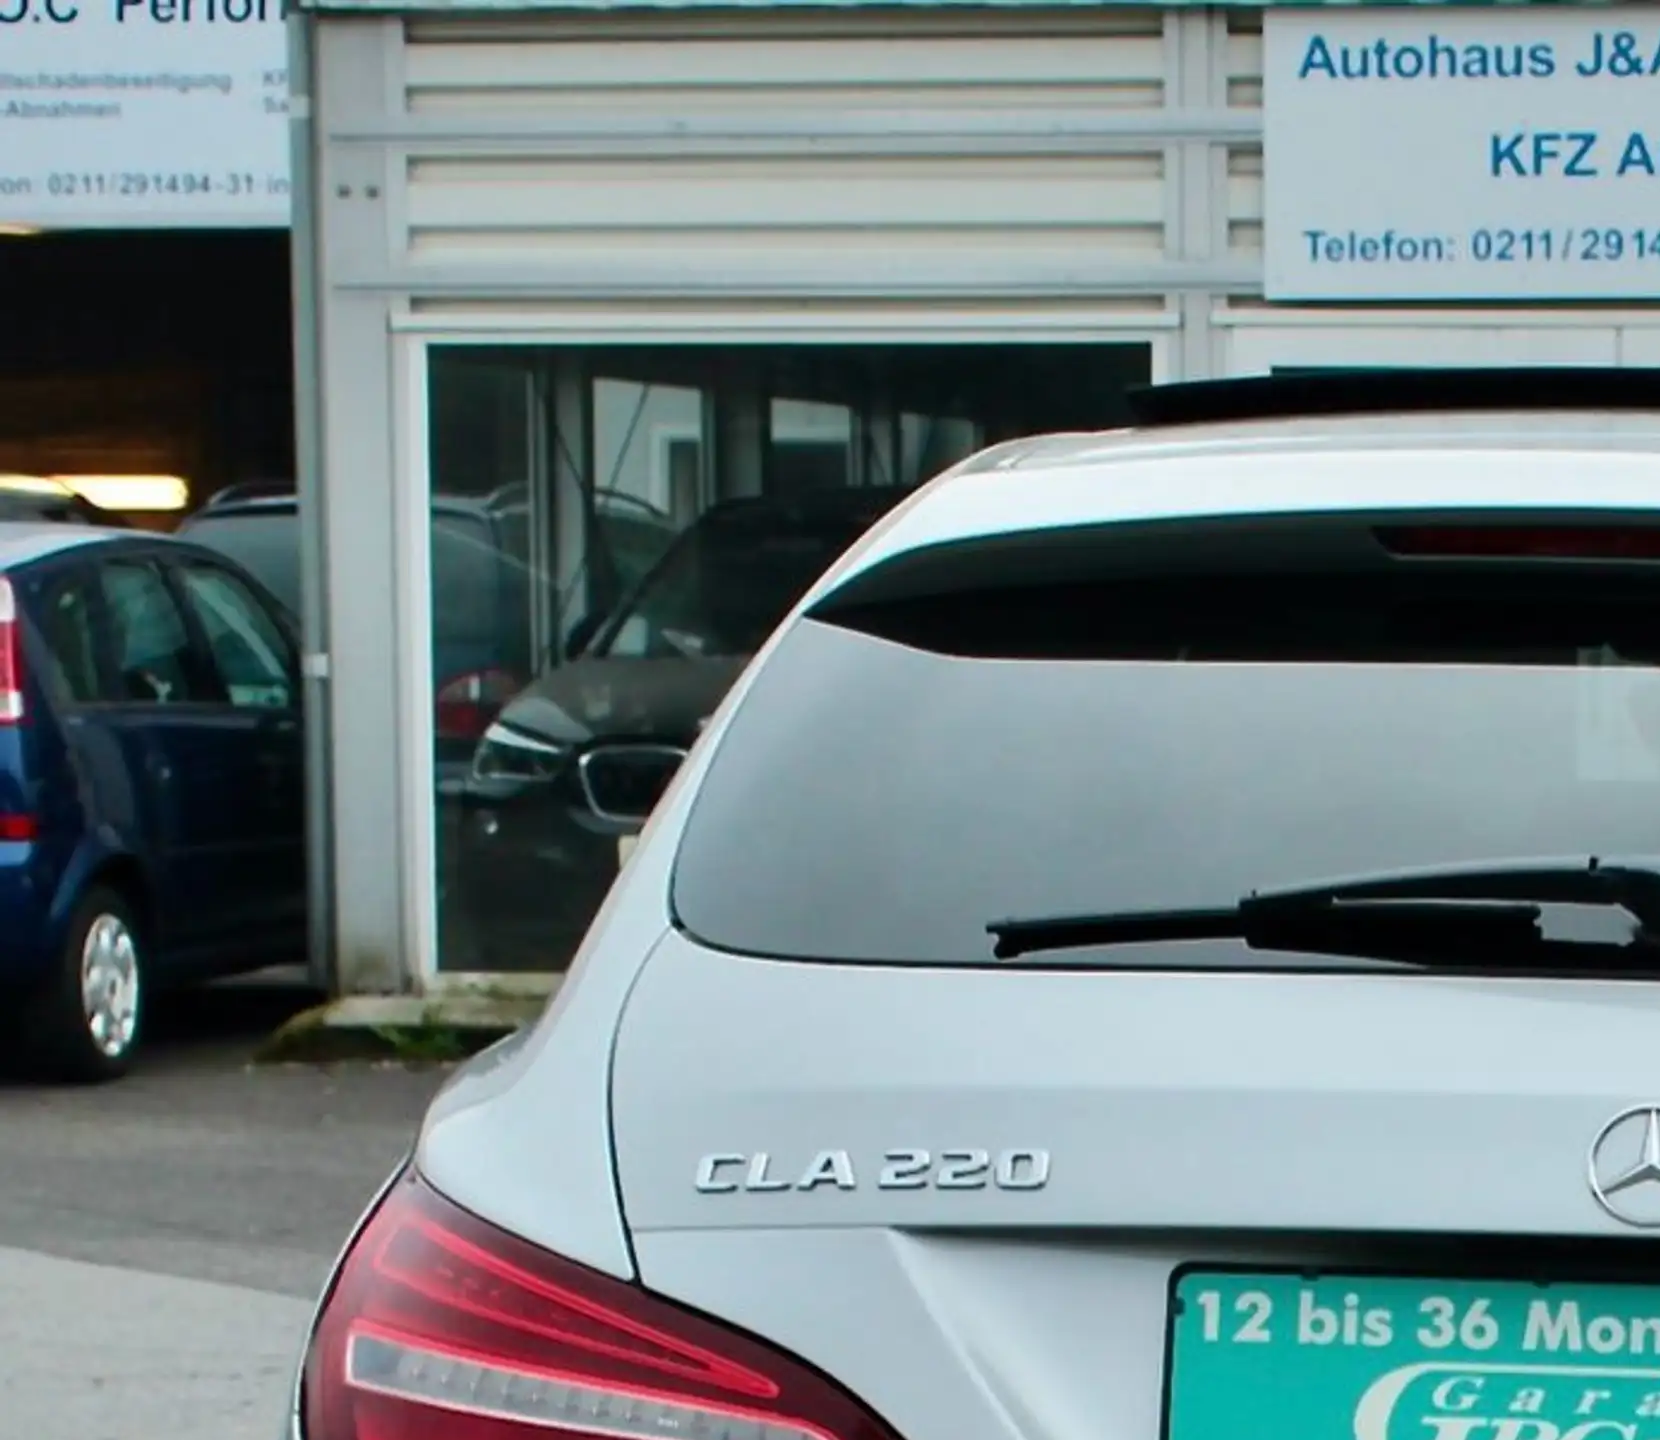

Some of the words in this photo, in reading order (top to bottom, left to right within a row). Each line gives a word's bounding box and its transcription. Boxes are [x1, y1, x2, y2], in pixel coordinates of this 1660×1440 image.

[1298, 33, 1556, 79] Autohaus
[1491, 132, 1598, 177] KFZ
[1303, 229, 1456, 263] Telefon:
[695, 1148, 859, 1194] CLA
[877, 1146, 1053, 1192] 220
[1197, 1290, 1274, 1344] 12
[1297, 1291, 1394, 1347] bis
[1416, 1295, 1501, 1350] 36
